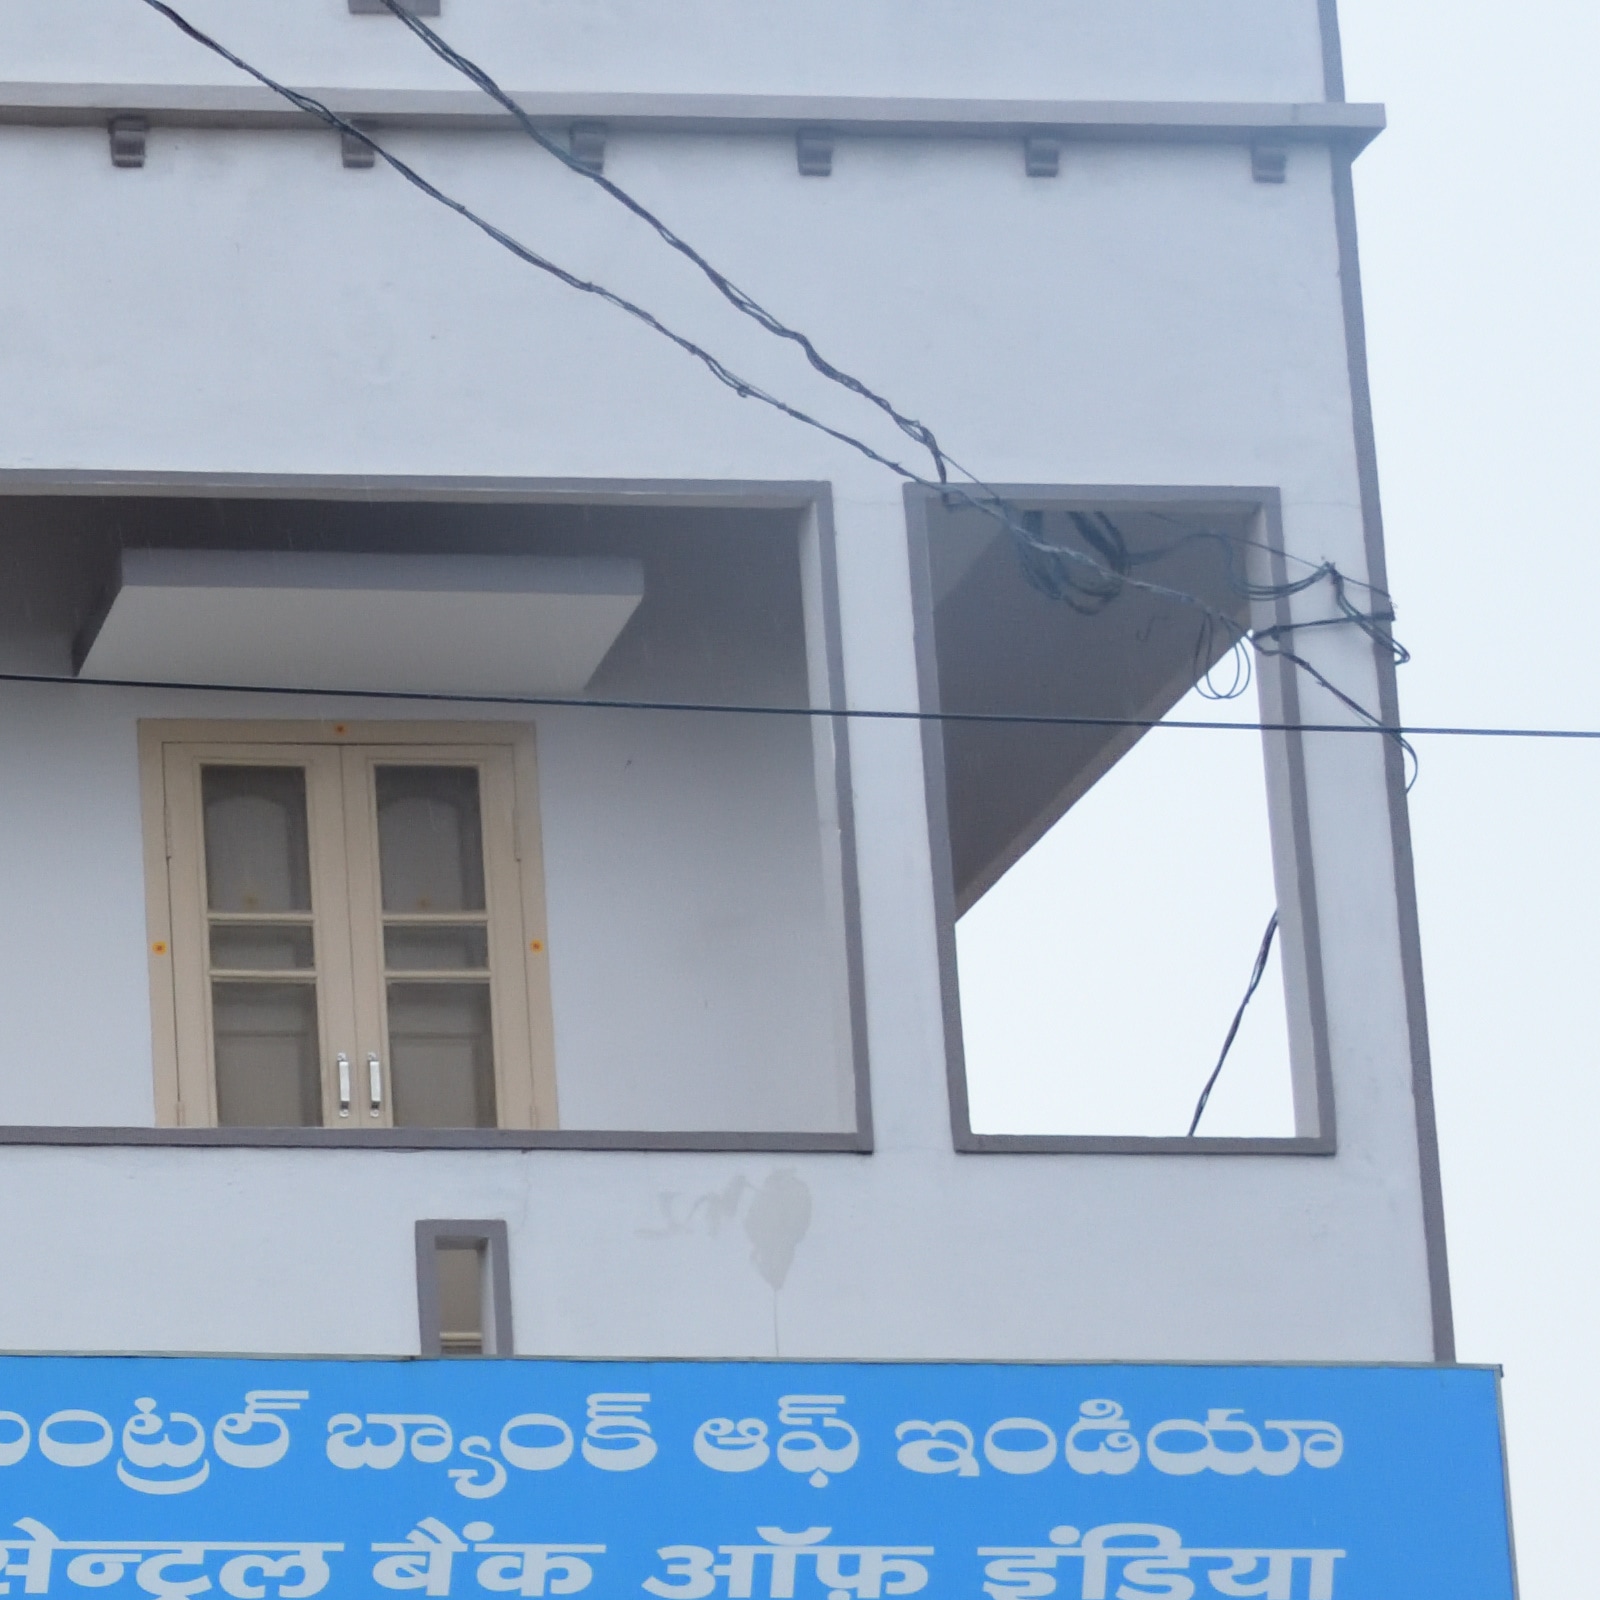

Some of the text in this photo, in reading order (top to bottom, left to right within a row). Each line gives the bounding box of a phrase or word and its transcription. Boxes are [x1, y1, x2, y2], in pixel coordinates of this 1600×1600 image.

[325, 1391, 658, 1499] బ్యాంక్
[693, 1394, 860, 1489] ఆఫ్
[895, 1398, 1344, 1477] ఇండియా
[371, 1516, 606, 1598] बैंक
